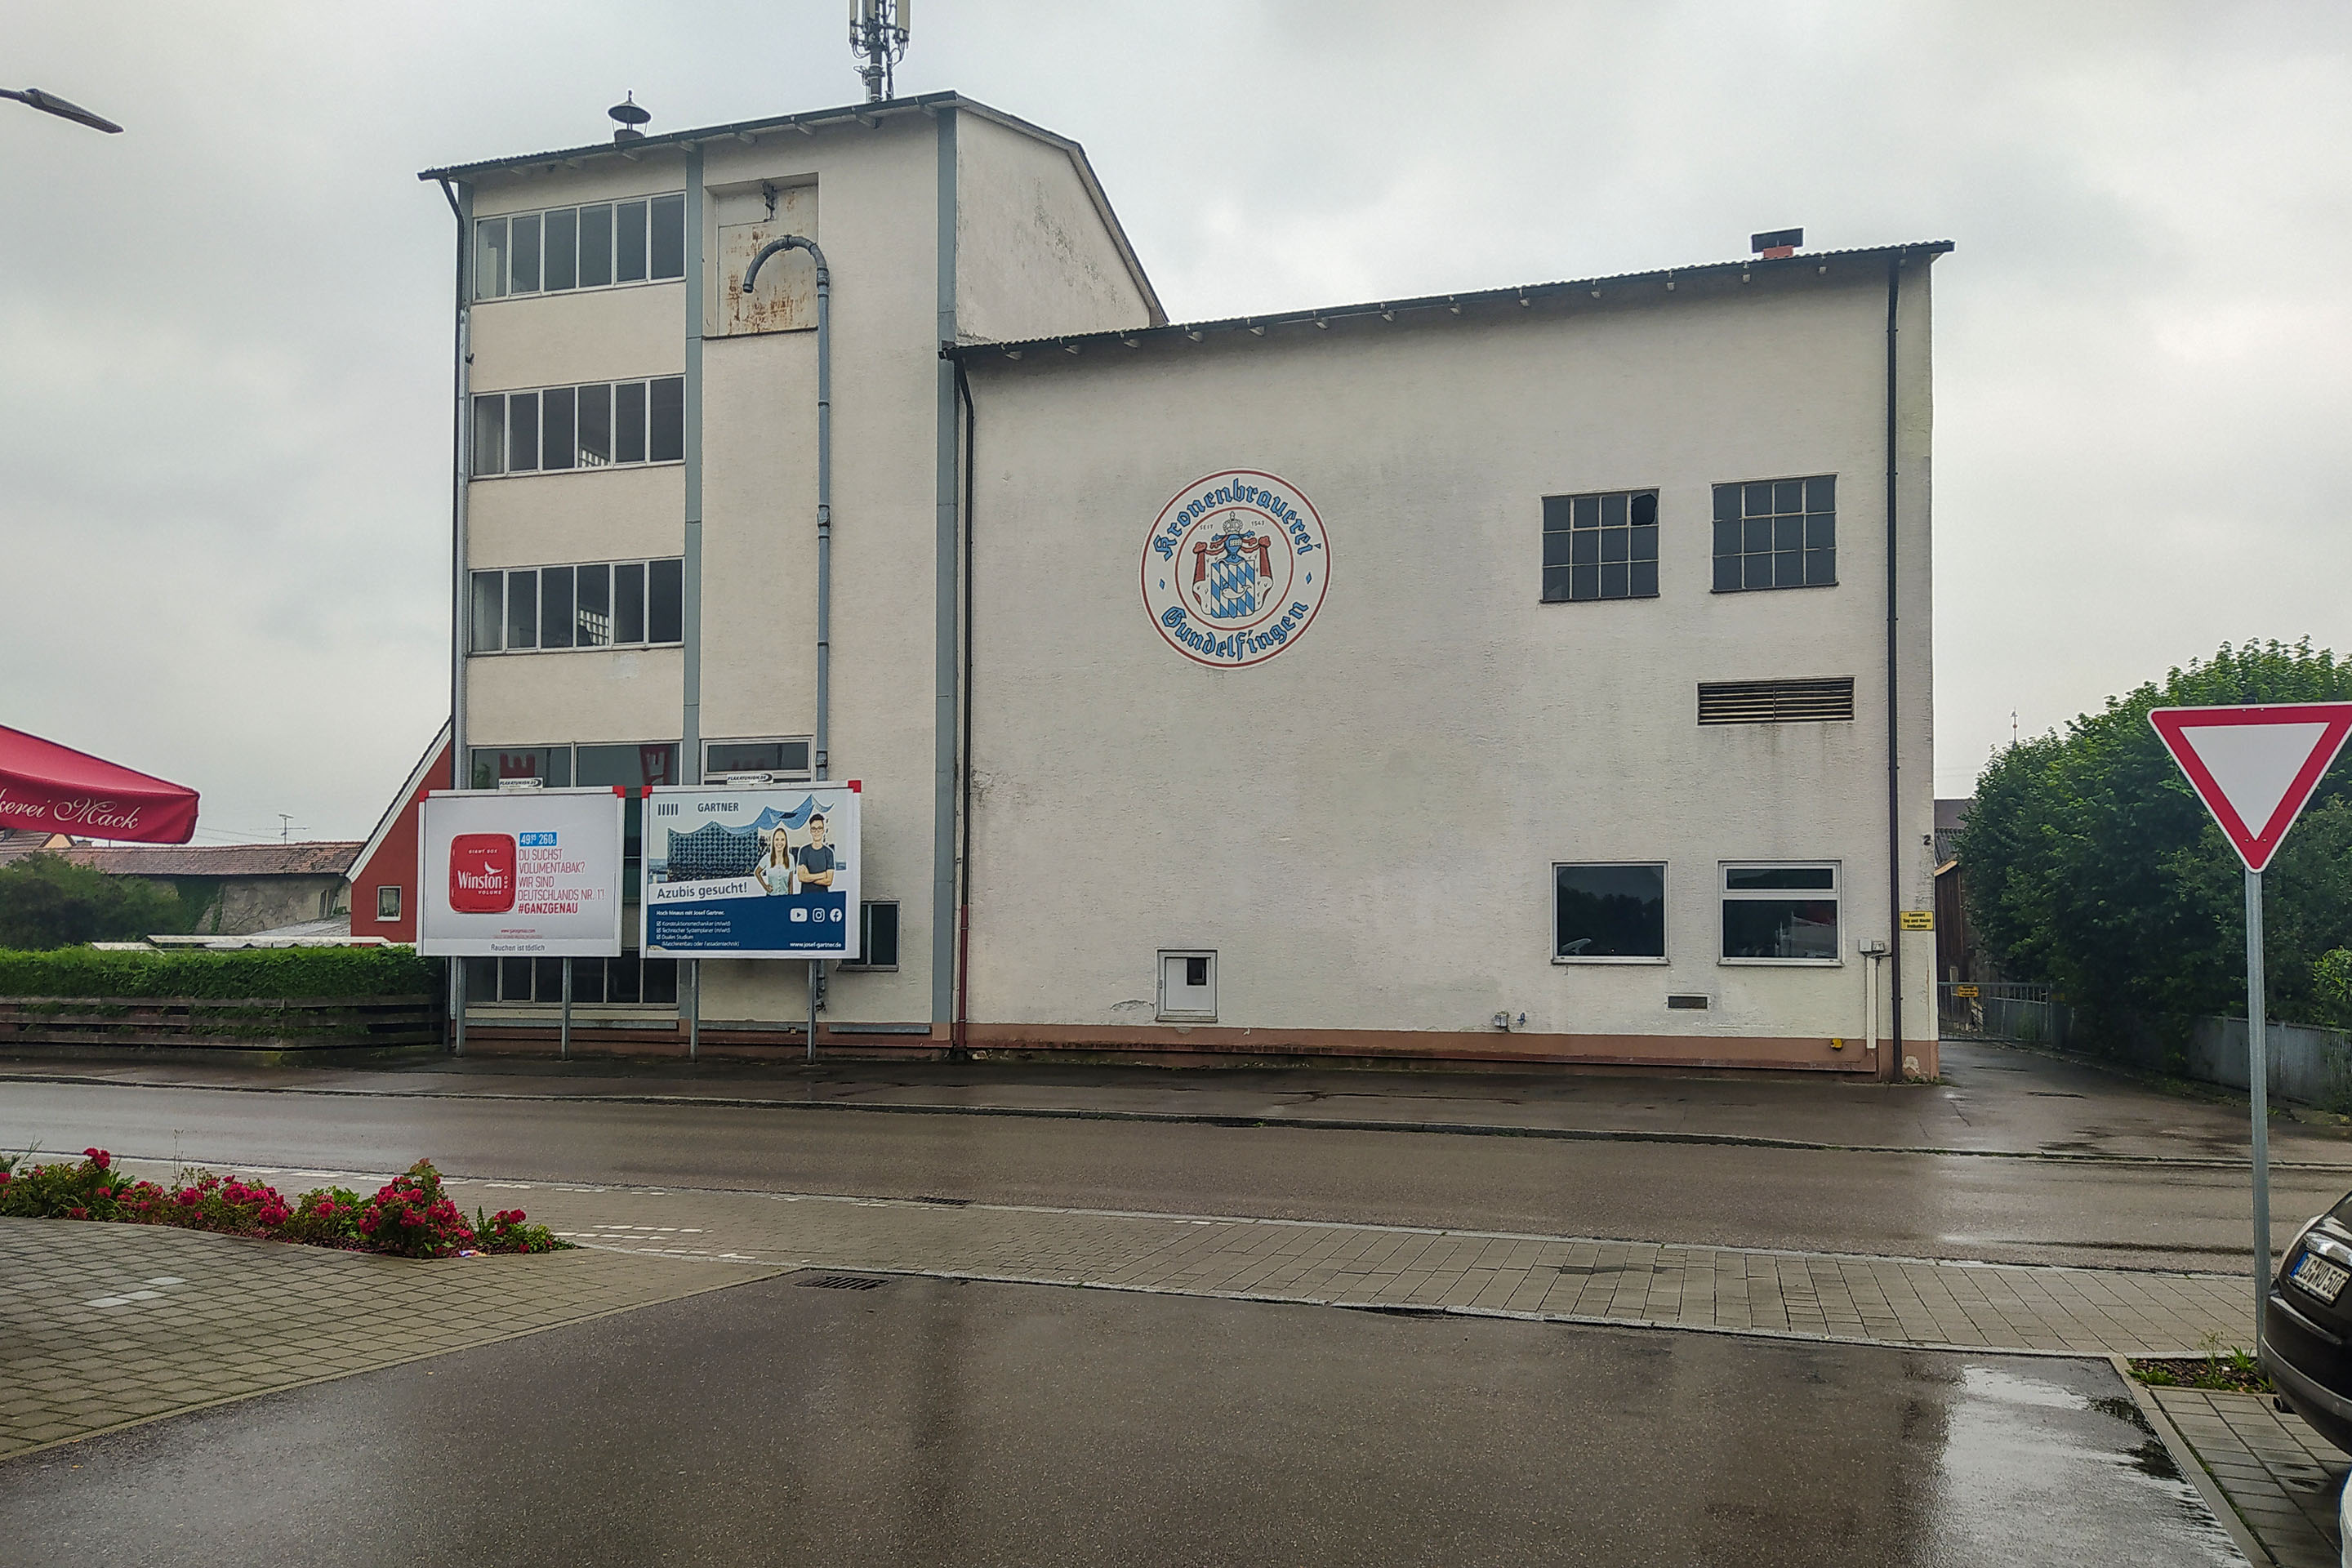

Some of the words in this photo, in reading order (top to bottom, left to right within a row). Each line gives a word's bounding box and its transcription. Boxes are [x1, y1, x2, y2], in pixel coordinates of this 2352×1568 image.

[1153, 477, 1321, 562] Kronenbrauerei
[1160, 600, 1310, 662] Gundelfingen
[53, 798, 142, 830] Mack
[697, 802, 739, 813] GARTNER
[519, 849, 530, 861] DU
[532, 849, 563, 861] SUCHST
[519, 861, 586, 874] VOLUMENTABAK?
[457, 870, 501, 889] Winston
[518, 876, 534, 888] WIR
[535, 875, 555, 888] SIND
[518, 889, 579, 902] DEUTSCHLANDS
[581, 889, 595, 900] NR.
[657, 885, 695, 899] Azubis
[698, 882, 747, 899] gesucht!
[518, 902, 578, 914] #GANZGENAU
[491, 943, 516, 951] Rauchen
